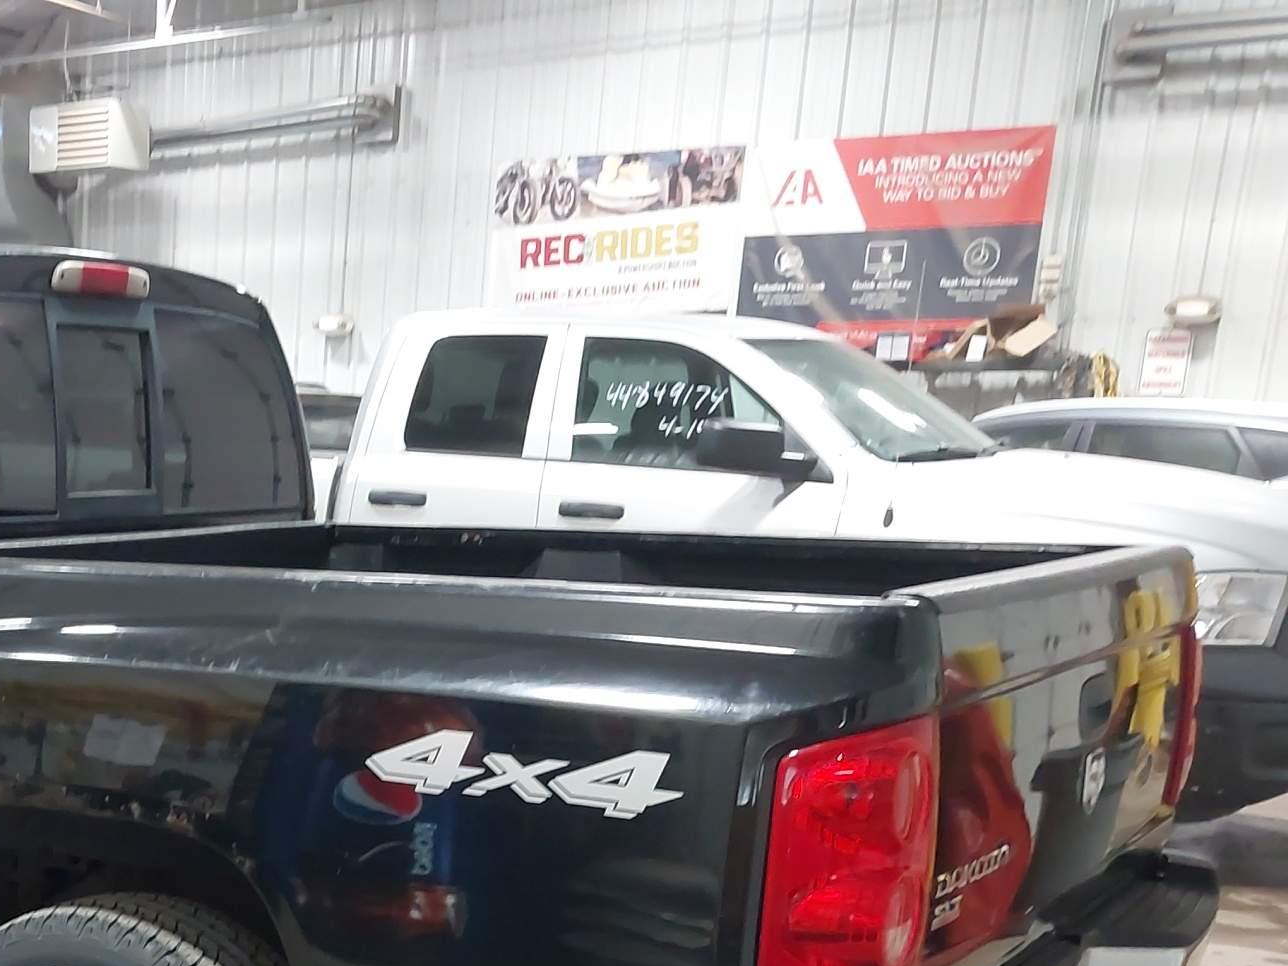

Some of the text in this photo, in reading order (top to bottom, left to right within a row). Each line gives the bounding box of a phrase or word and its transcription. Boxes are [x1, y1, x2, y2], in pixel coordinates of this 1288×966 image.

[857, 157, 887, 176] IAA
[891, 155, 941, 174] TIMED
[875, 167, 1022, 190] INTRODUCING A NEW
[883, 188, 913, 204] WAY
[916, 187, 934, 202] TO
[979, 184, 1011, 199] BUY
[519, 220, 700, 270] REC RIDES
[364, 729, 685, 821] 4x4
[935, 843, 1010, 899] DAKOTA
